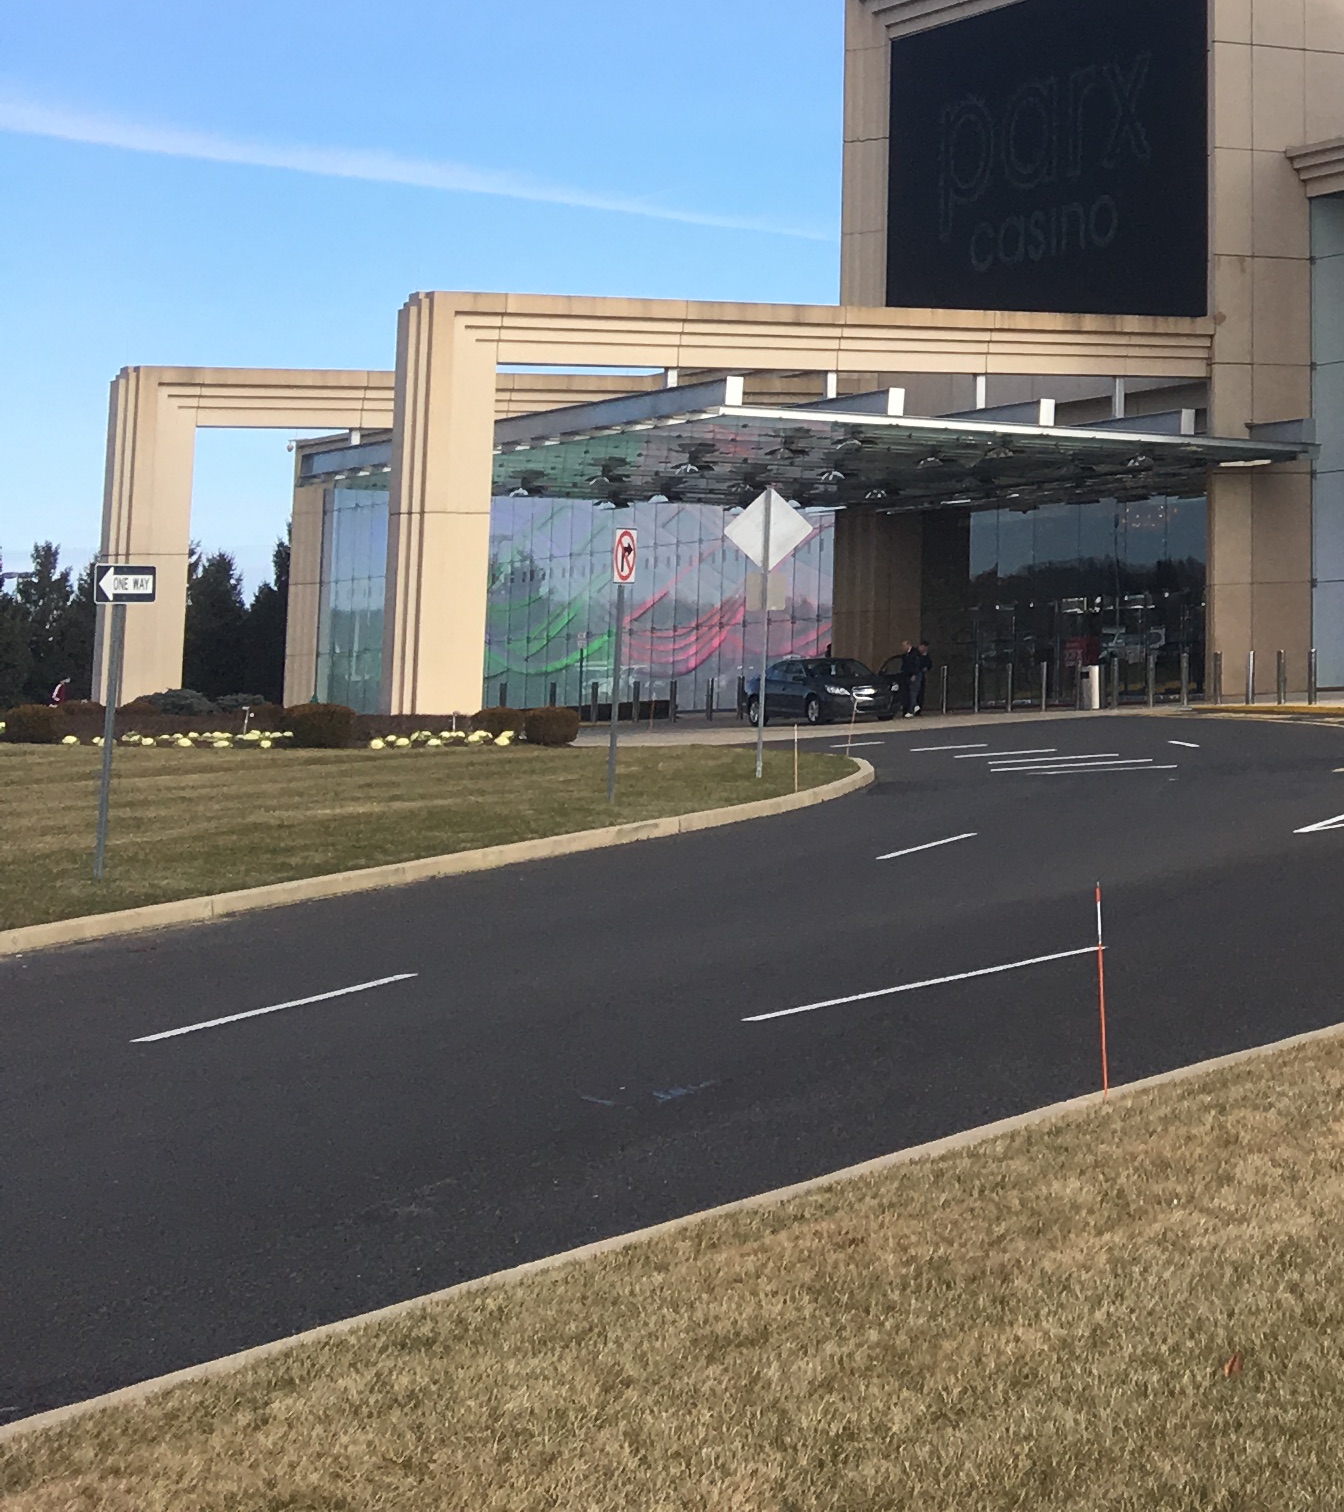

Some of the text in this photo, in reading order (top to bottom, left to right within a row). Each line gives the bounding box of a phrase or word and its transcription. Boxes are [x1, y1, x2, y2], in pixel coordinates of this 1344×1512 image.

[938, 50, 1153, 241] parx
[969, 193, 1119, 273] casino
[113, 577, 151, 591] ONE WAY
